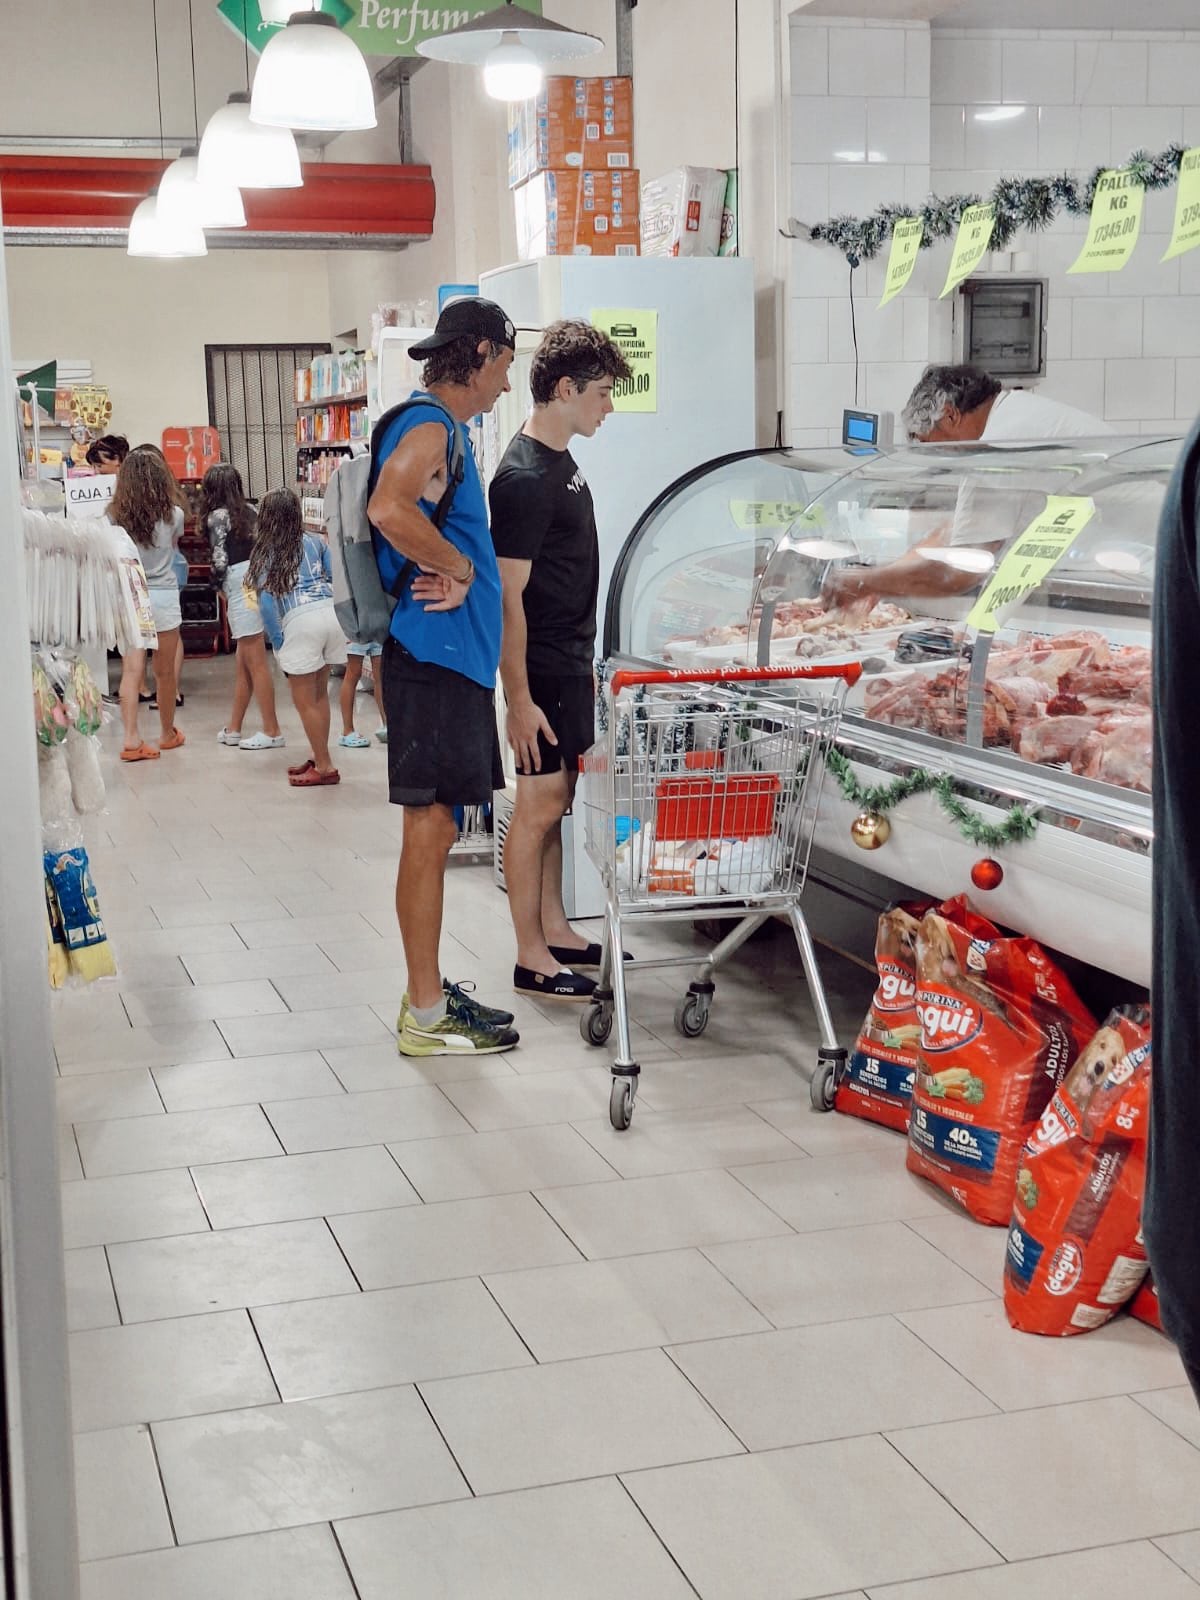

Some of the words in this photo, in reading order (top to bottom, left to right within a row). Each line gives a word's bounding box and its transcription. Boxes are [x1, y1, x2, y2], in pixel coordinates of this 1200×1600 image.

[357, 0, 486, 44] Perfum
[1109, 195, 1128, 211] KG
[70, 488, 102, 501] CAJA
[106, 486, 113, 497] 1
[922, 991, 962, 1010] PURINA
[1045, 1024, 1062, 1079] ADULTOS
[866, 1058, 881, 1075] 15
[916, 1109, 927, 1129] 15
[1090, 1152, 1112, 1194] ADULTOS
[1048, 1242, 1078, 1291] dogui
